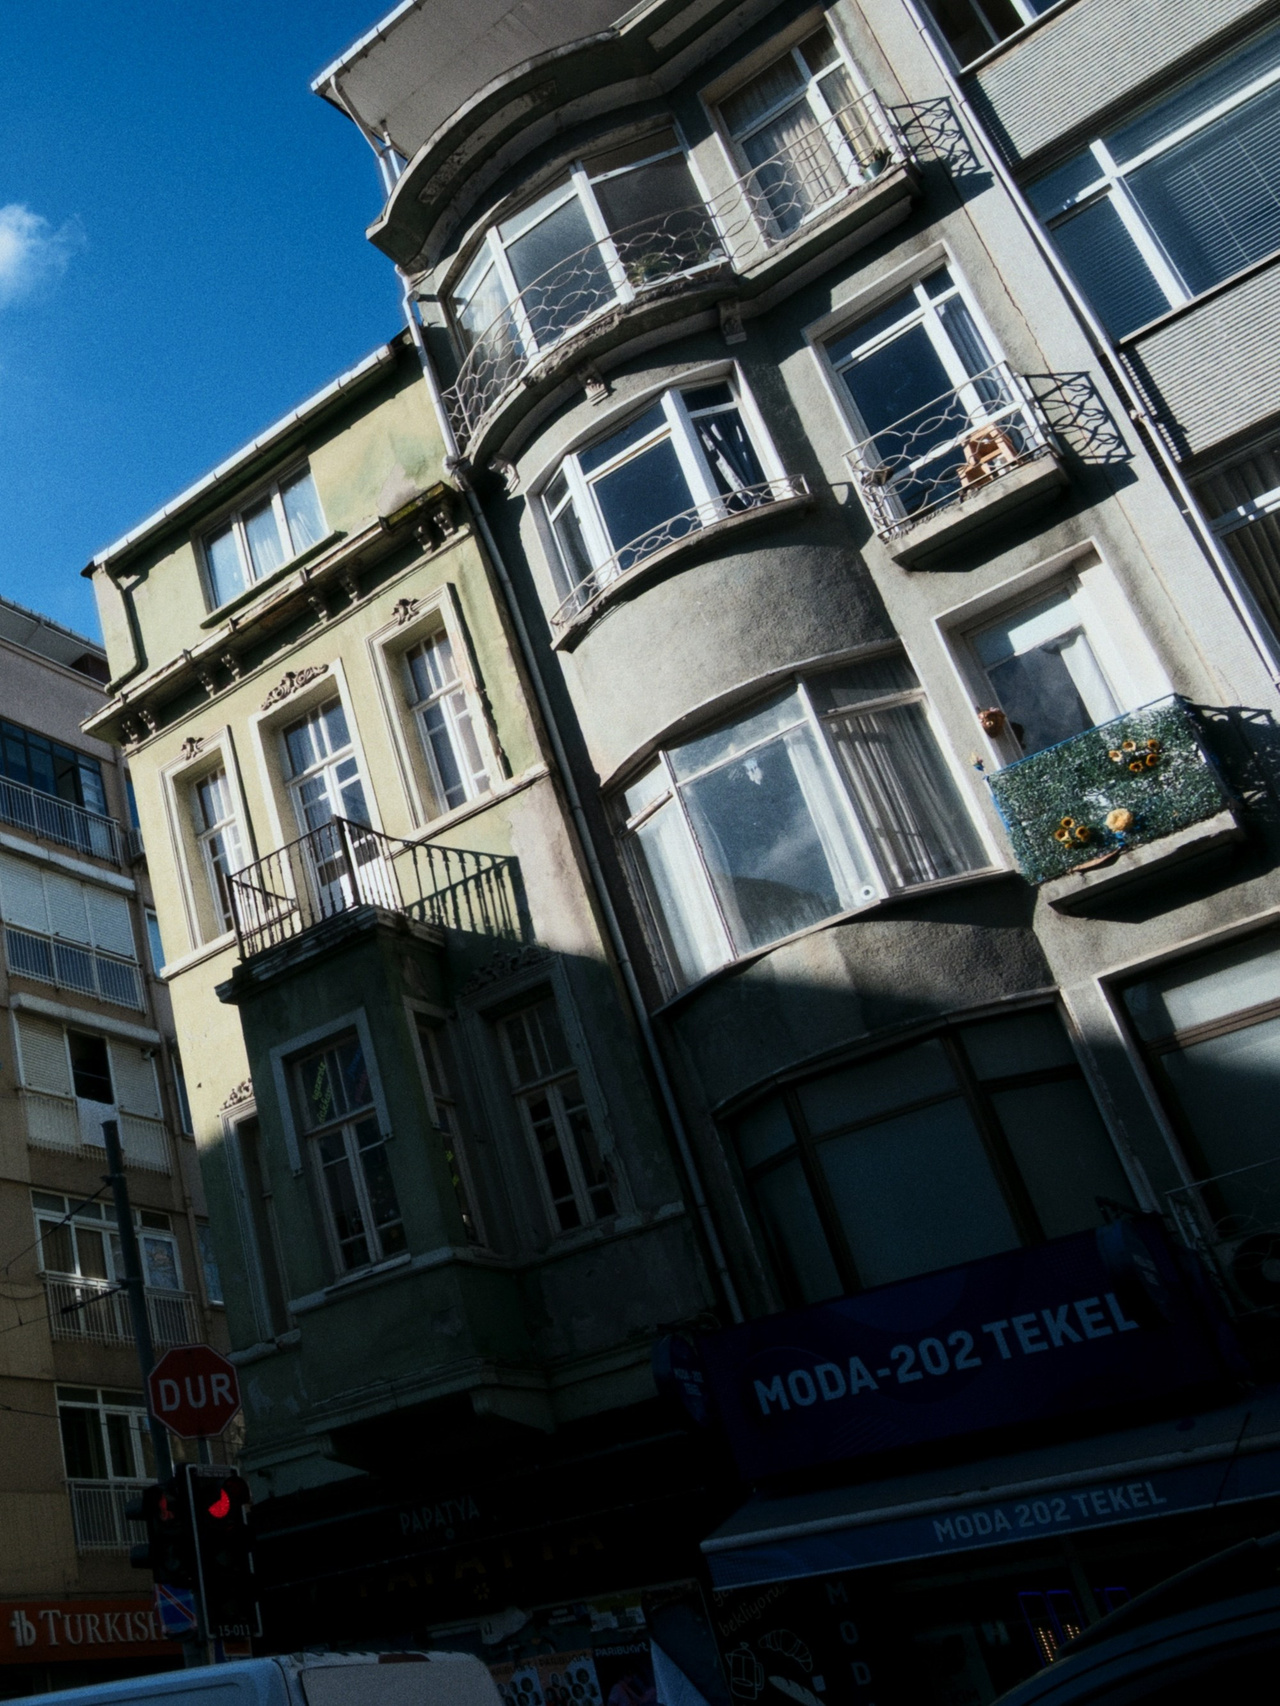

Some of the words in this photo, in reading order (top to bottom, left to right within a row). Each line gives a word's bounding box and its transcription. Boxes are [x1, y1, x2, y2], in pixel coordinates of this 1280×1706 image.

[753, 1329, 983, 1416] MODA-202
[981, 1292, 1141, 1360] TEKEL
[158, 1372, 236, 1412] DUR
[398, 1495, 481, 1536] PAPATYA
[932, 1508, 1013, 1543] MODA
[1015, 1497, 1072, 1528] 202
[1072, 1480, 1168, 1518] TEKEL
[218, 1624, 251, 1637] 15-011
